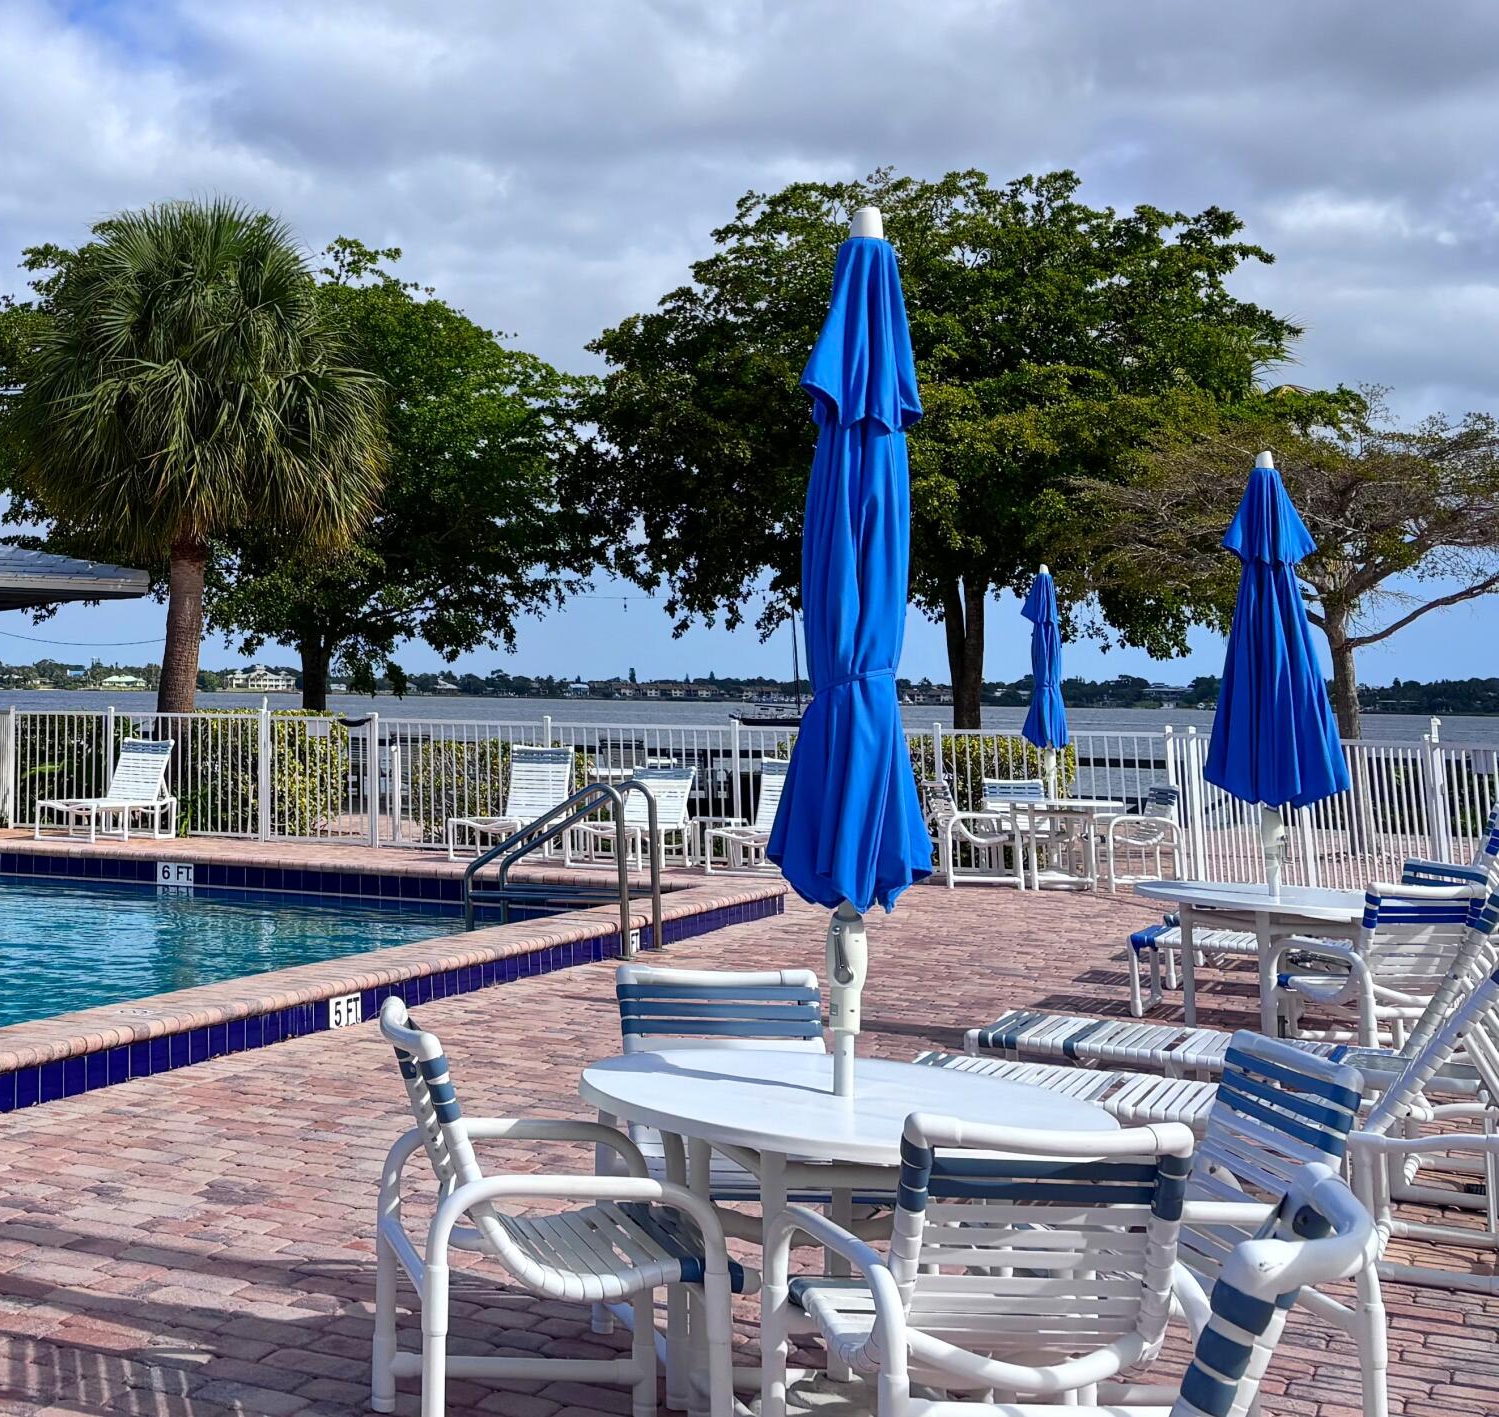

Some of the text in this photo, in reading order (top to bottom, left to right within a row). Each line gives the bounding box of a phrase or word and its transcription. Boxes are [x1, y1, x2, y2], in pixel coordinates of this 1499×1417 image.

[161, 864, 192, 881] 6 FT.
[334, 1000, 342, 1027] 5
